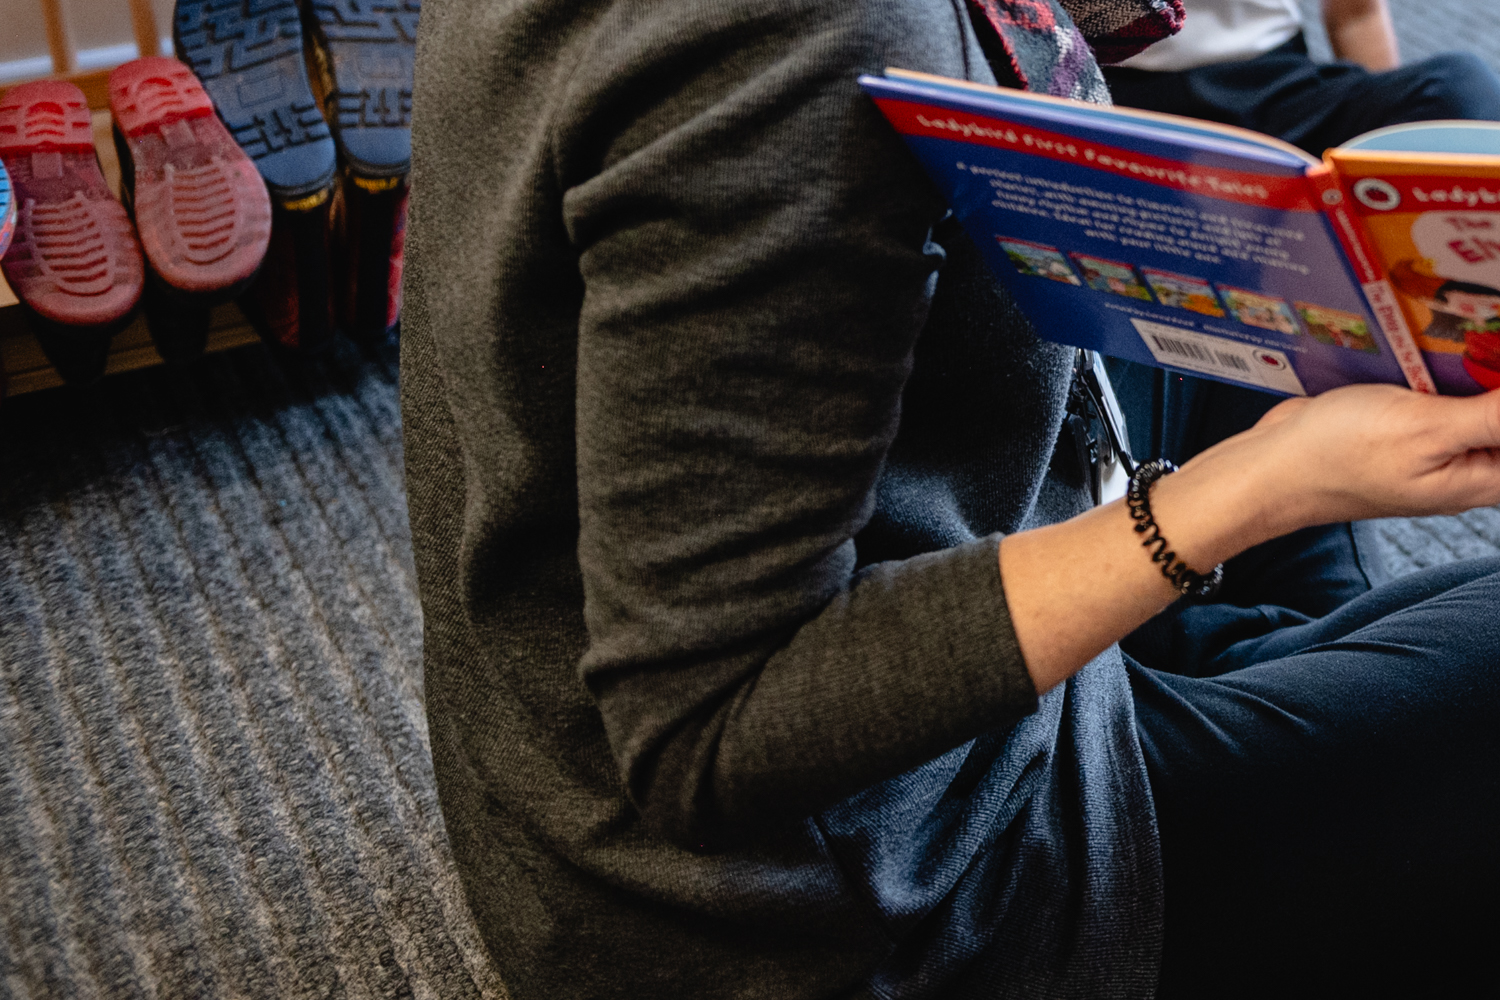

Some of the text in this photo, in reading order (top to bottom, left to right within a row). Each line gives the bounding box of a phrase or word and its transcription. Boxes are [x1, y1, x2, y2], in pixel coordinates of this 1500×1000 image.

[916, 113, 1268, 199] Ladybird First Favourite Tales
[1444, 215, 1494, 232] The
